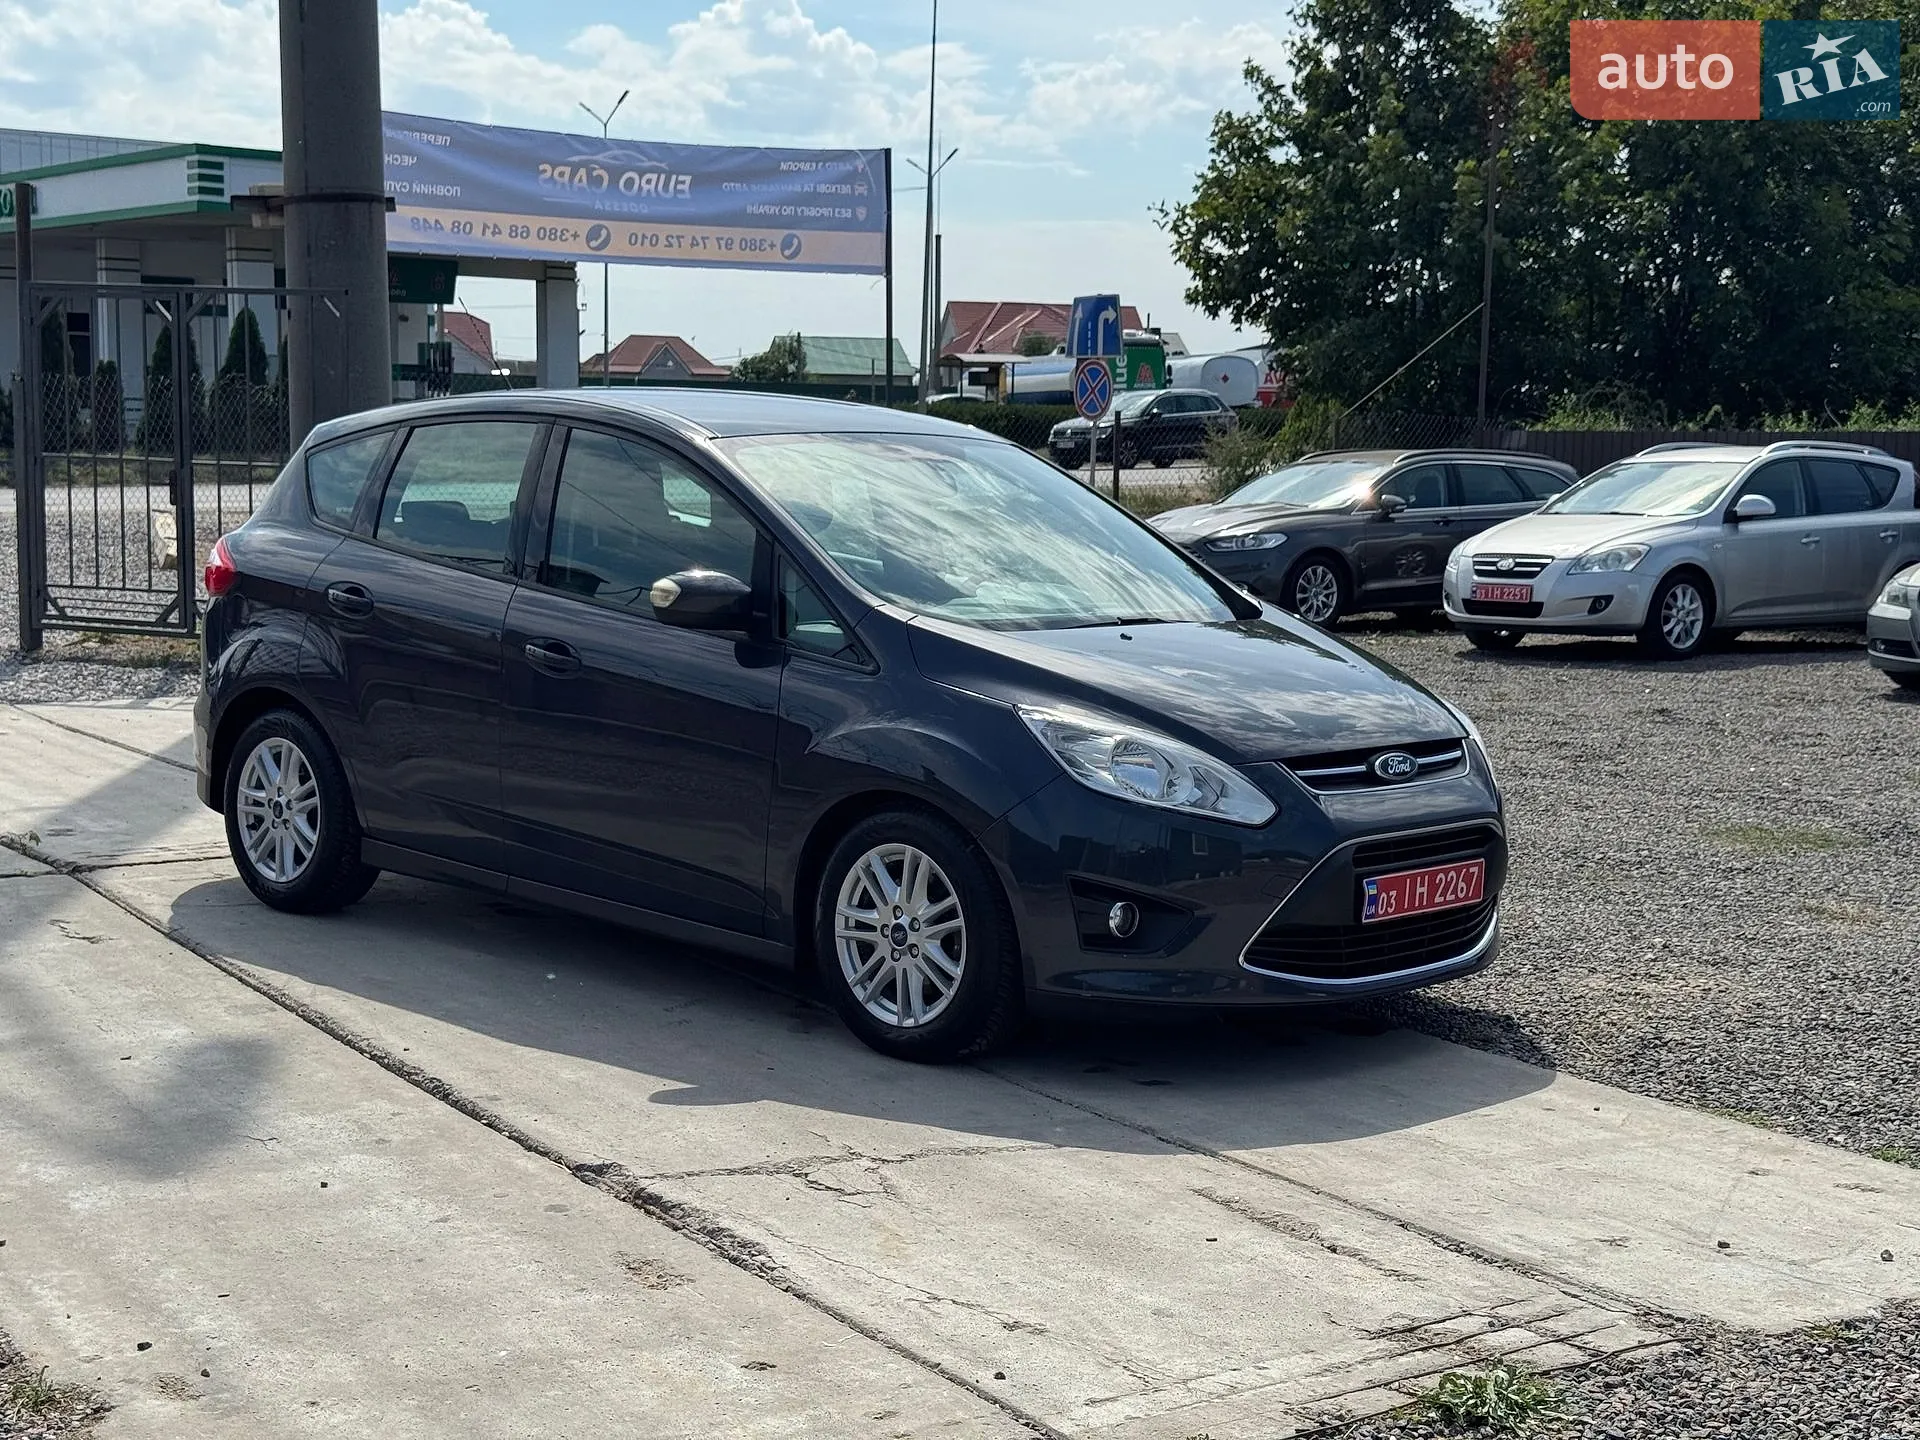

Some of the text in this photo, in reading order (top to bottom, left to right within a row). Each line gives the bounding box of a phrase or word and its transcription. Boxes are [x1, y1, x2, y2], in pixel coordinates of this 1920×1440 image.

[1503, 588, 1527, 600] 2251
[1388, 757, 1411, 773] Ford
[1378, 890, 1397, 915] 03
[1434, 866, 1479, 903] 2267
